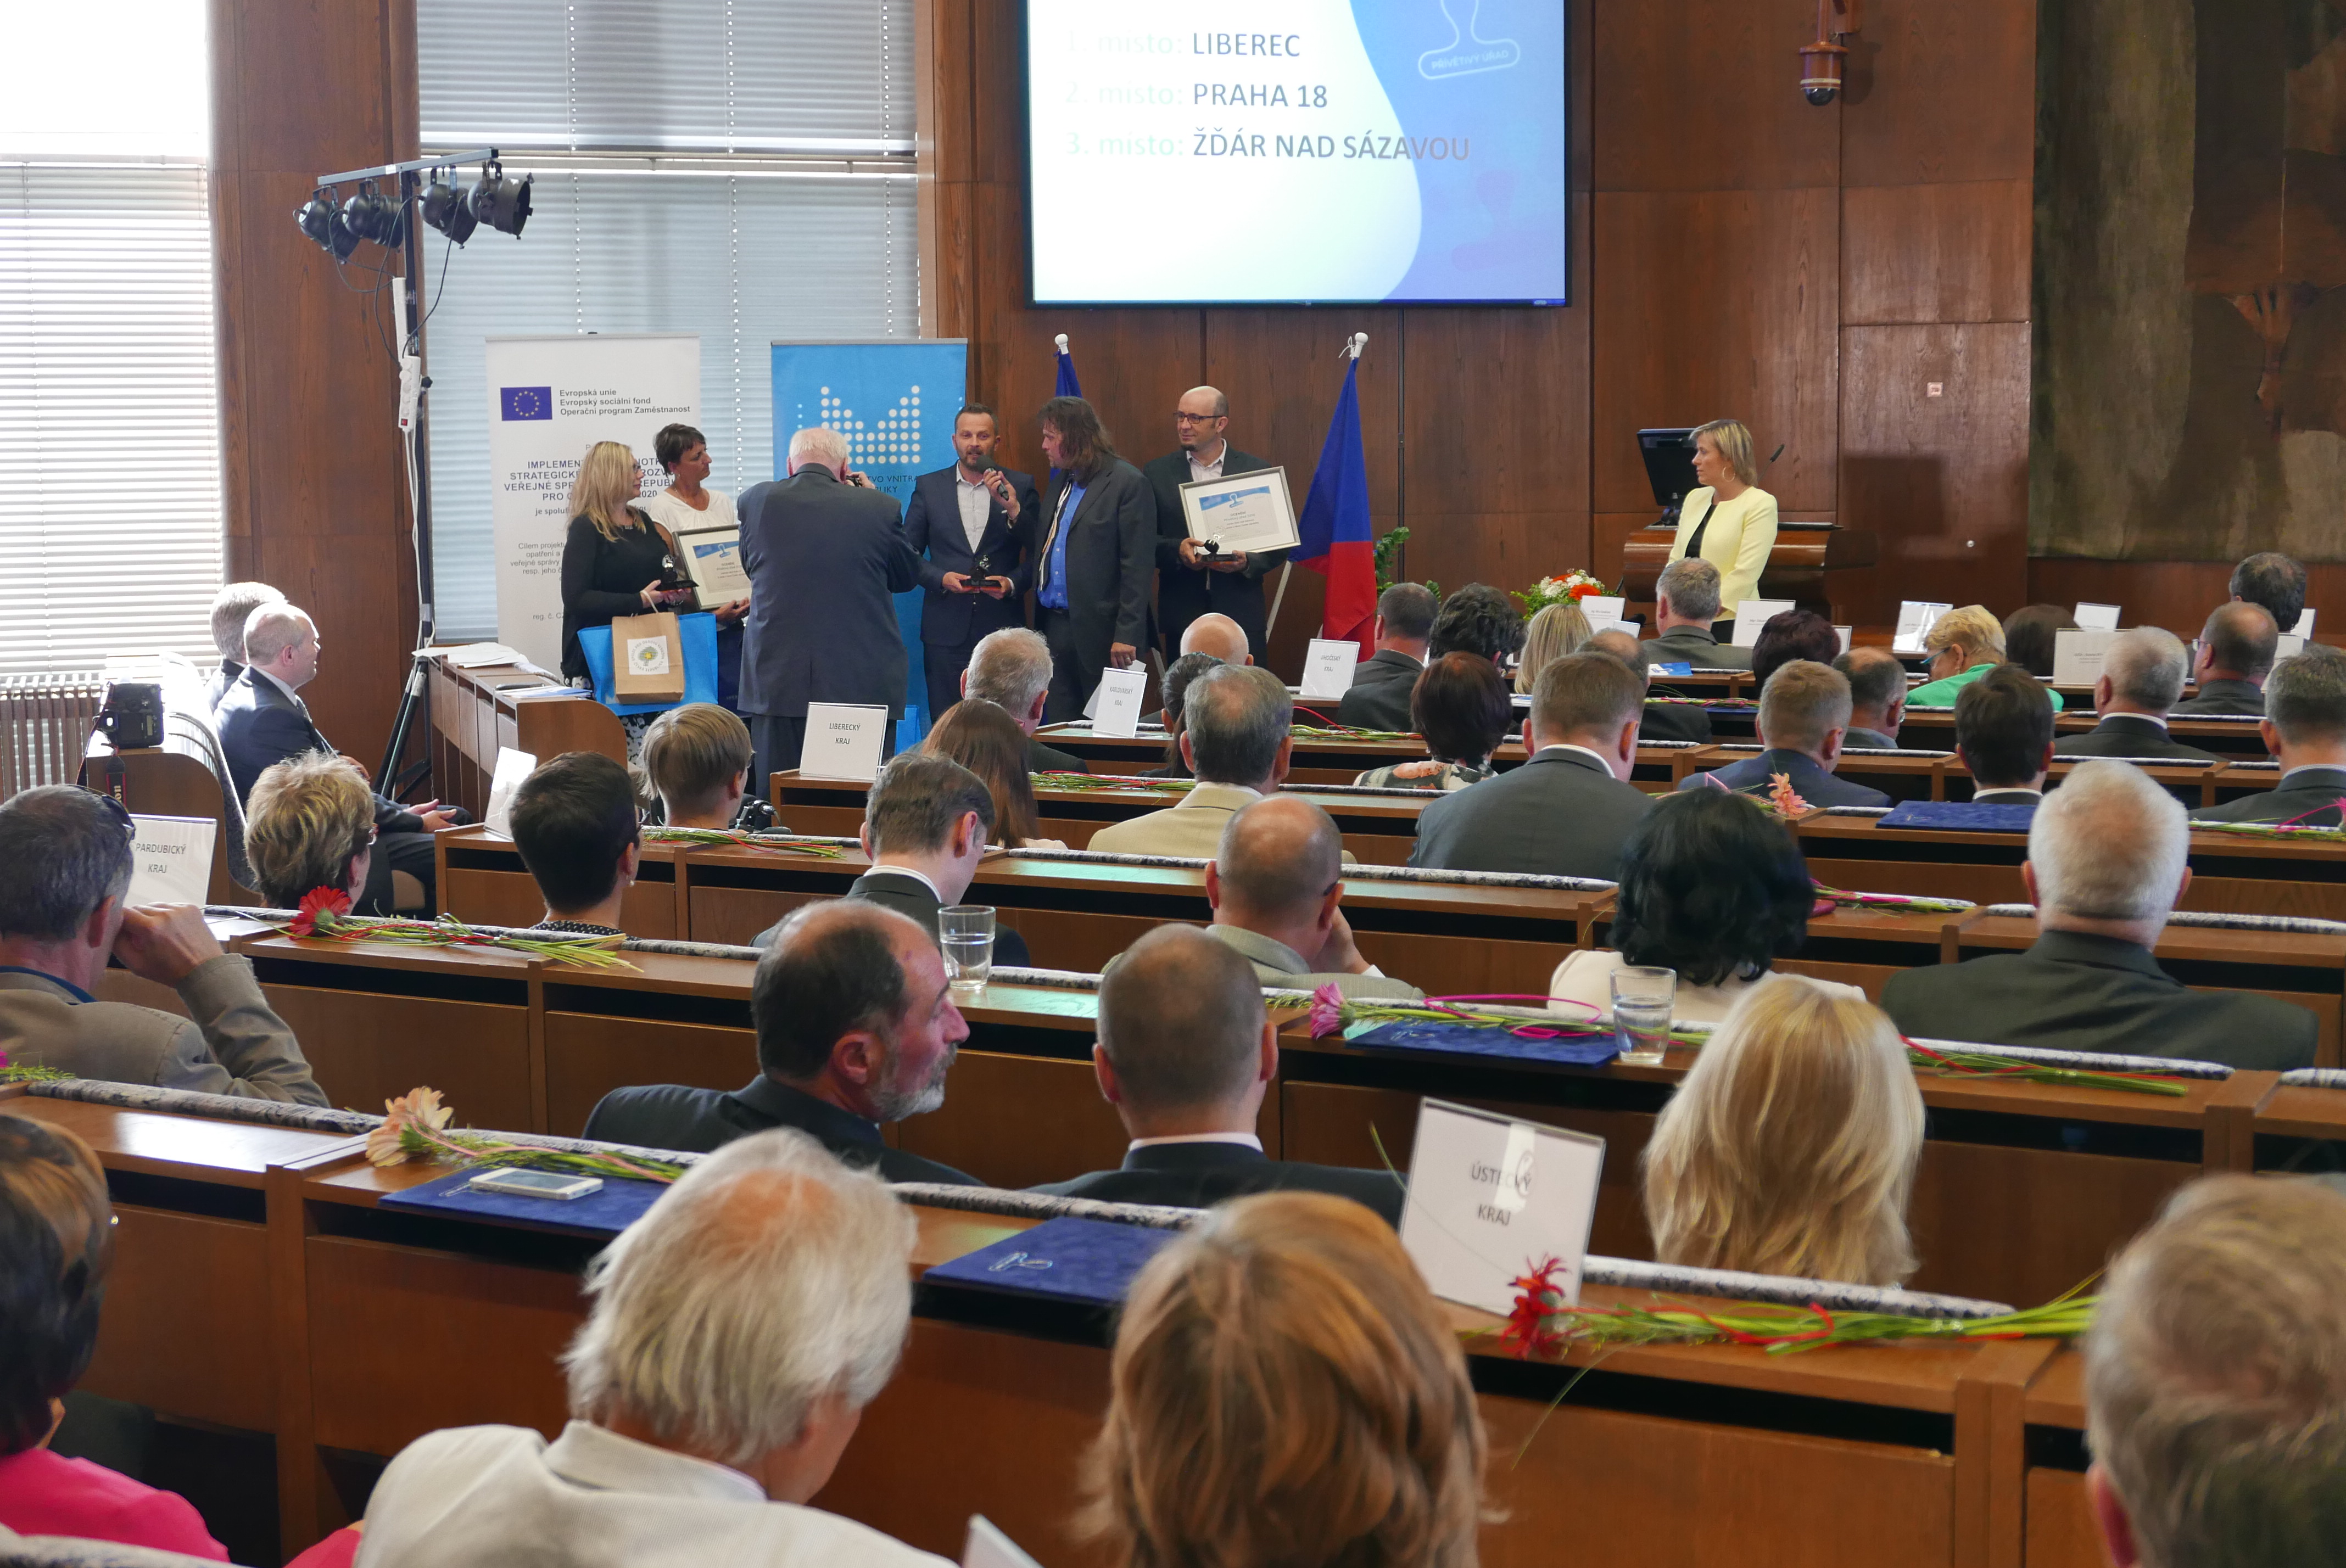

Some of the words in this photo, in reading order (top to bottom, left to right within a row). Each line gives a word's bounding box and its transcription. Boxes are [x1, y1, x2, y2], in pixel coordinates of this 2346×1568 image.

[1193, 32, 1300, 57] LIBEREC
[1194, 83, 1289, 108] PRAHA
[1298, 85, 1328, 108] 18
[1192, 126, 1265, 158] ŽĎÁR
[1276, 134, 1335, 158] NAD
[1343, 130, 1470, 161] SÁZAVOU
[560, 389, 597, 397] Evropská
[560, 398, 597, 406] Evropský
[560, 407, 597, 416] Operační
[634, 406, 690, 414] Zaměstnanost
[528, 460, 582, 469] IMPLEMEN
[504, 480, 551, 491] VEŘEJNÉ
[543, 492, 563, 501] PRO
[535, 508, 543, 517] je
[829, 723, 861, 731] LIBERECKÝ
[136, 843, 187, 854] PARDUBICKÝ
[148, 864, 167, 873] KRAJ
[1477, 1203, 1511, 1227] KRAJ
